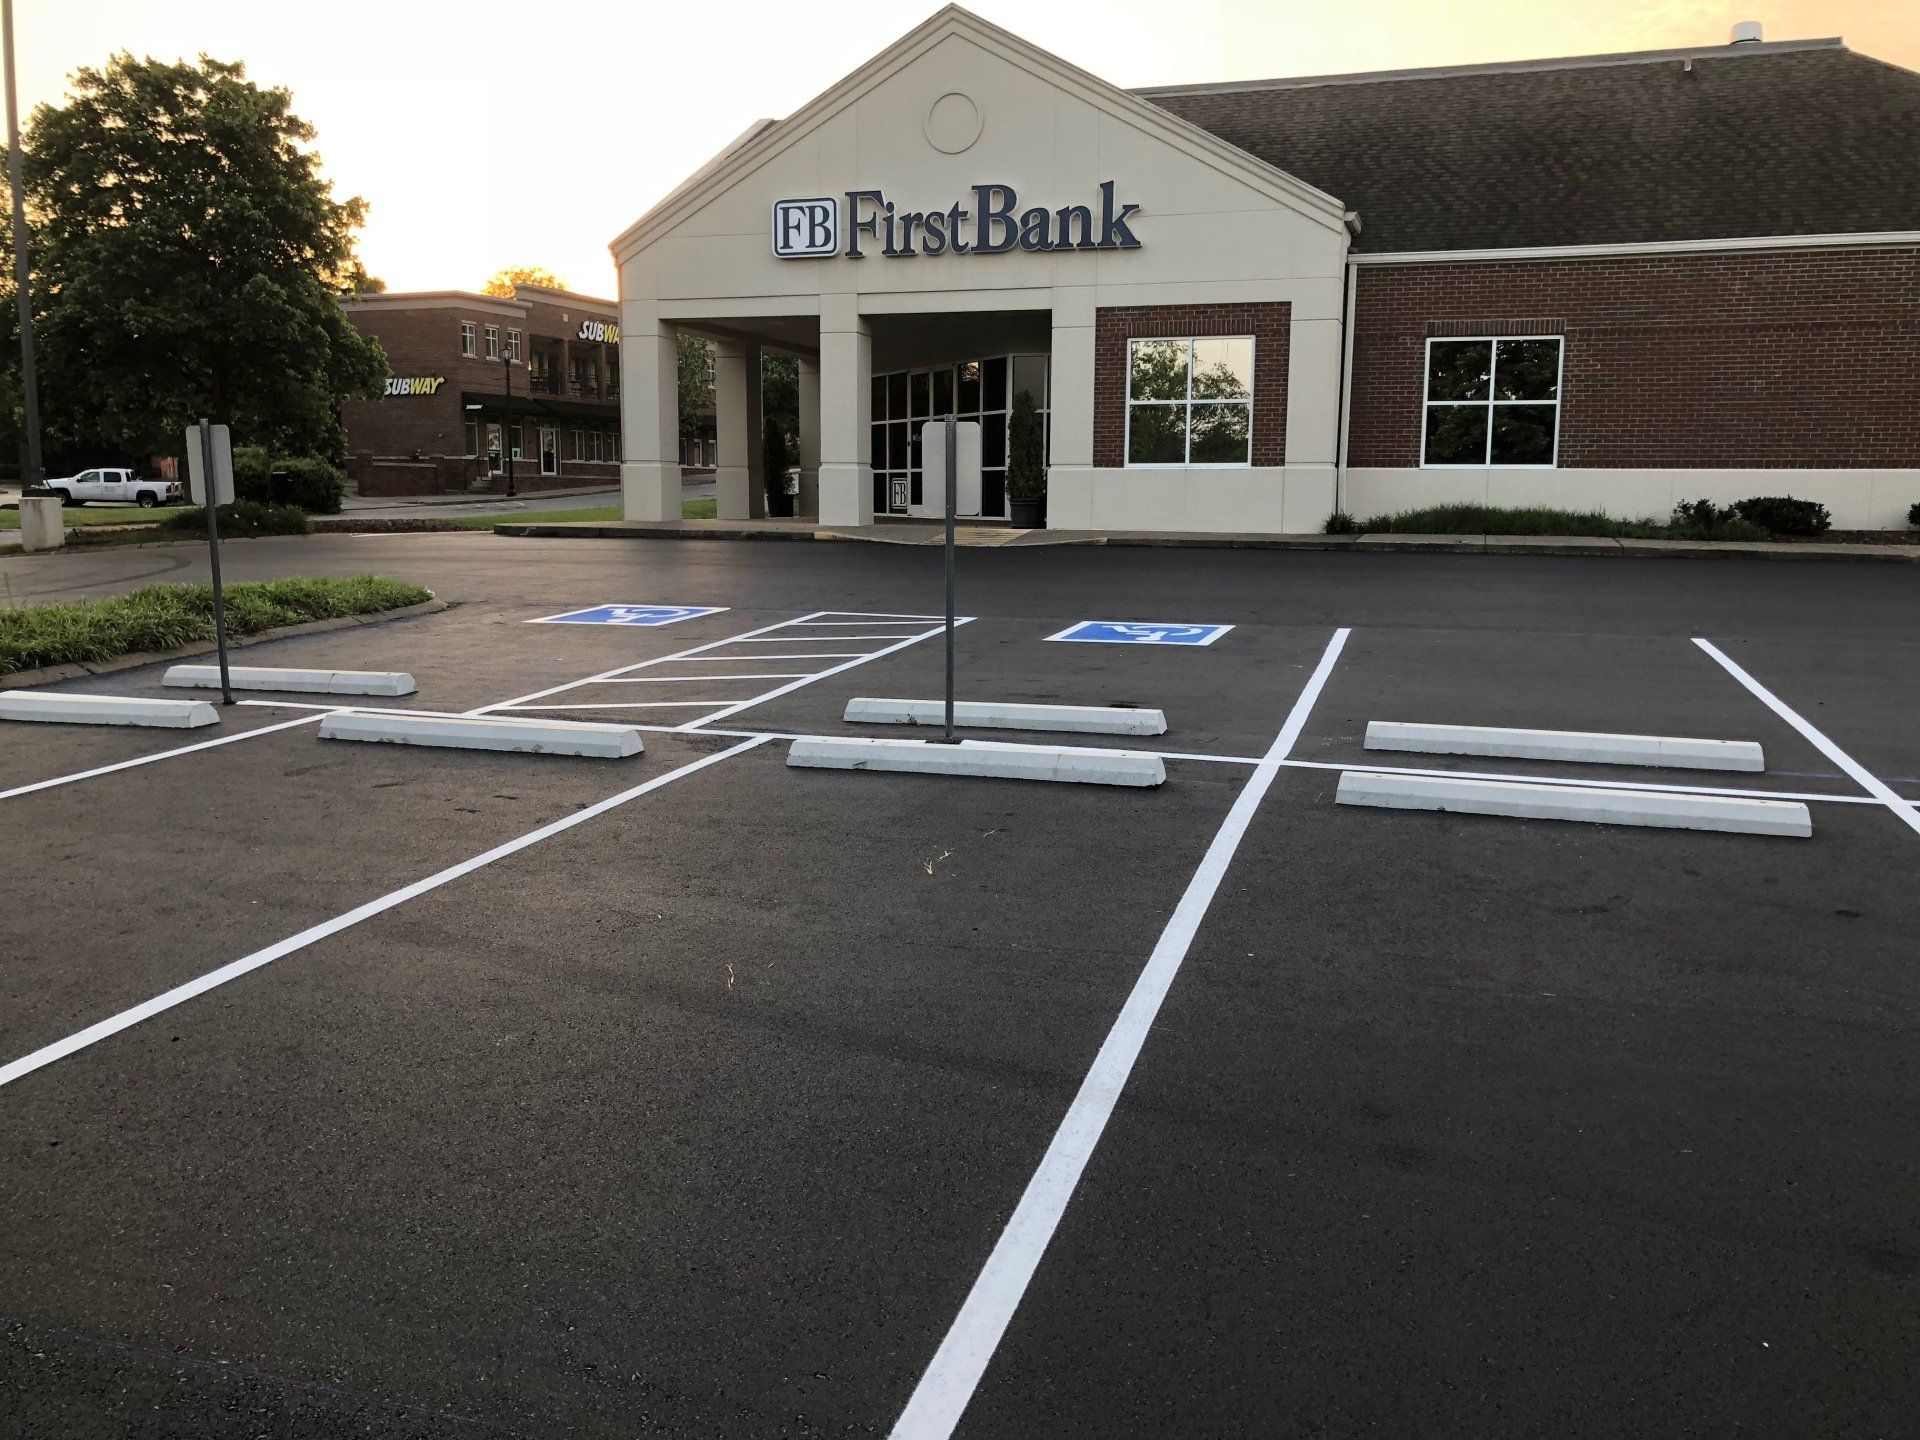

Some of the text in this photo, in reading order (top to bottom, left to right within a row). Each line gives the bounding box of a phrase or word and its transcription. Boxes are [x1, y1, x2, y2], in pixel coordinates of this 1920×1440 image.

[779, 205, 832, 250] FB
[845, 180, 1142, 258] FirstBank
[578, 320, 620, 344] SUBWA
[384, 376, 445, 395] SUBWAY
[893, 482, 906, 505] FB
